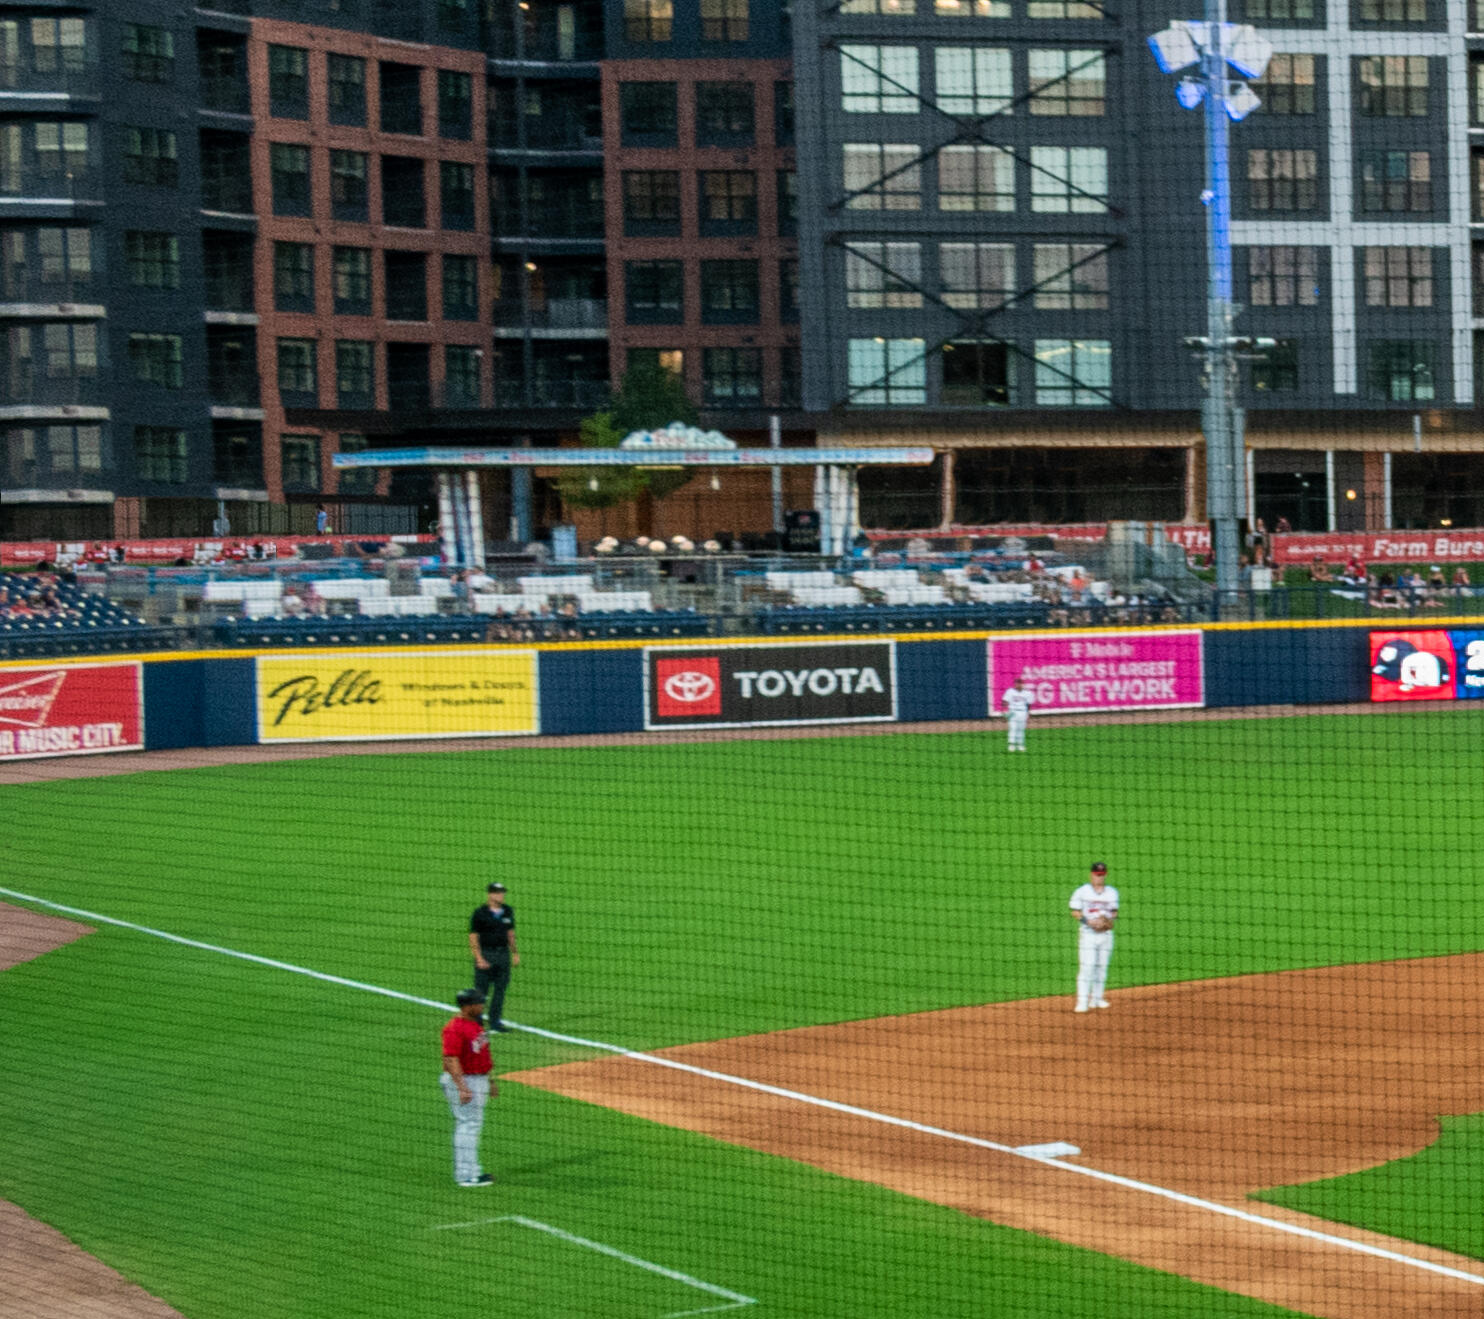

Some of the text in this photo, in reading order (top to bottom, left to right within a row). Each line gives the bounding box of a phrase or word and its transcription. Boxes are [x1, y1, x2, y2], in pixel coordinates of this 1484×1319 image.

[1372, 539, 1429, 558] Farm
[733, 667, 884, 698] TOYOTA
[1021, 661, 1177, 680] AMERICA'S LARGEST
[266, 669, 381, 726] Pella
[1060, 678, 1177, 702] NETWORK
[18, 726, 80, 752] MUSIC
